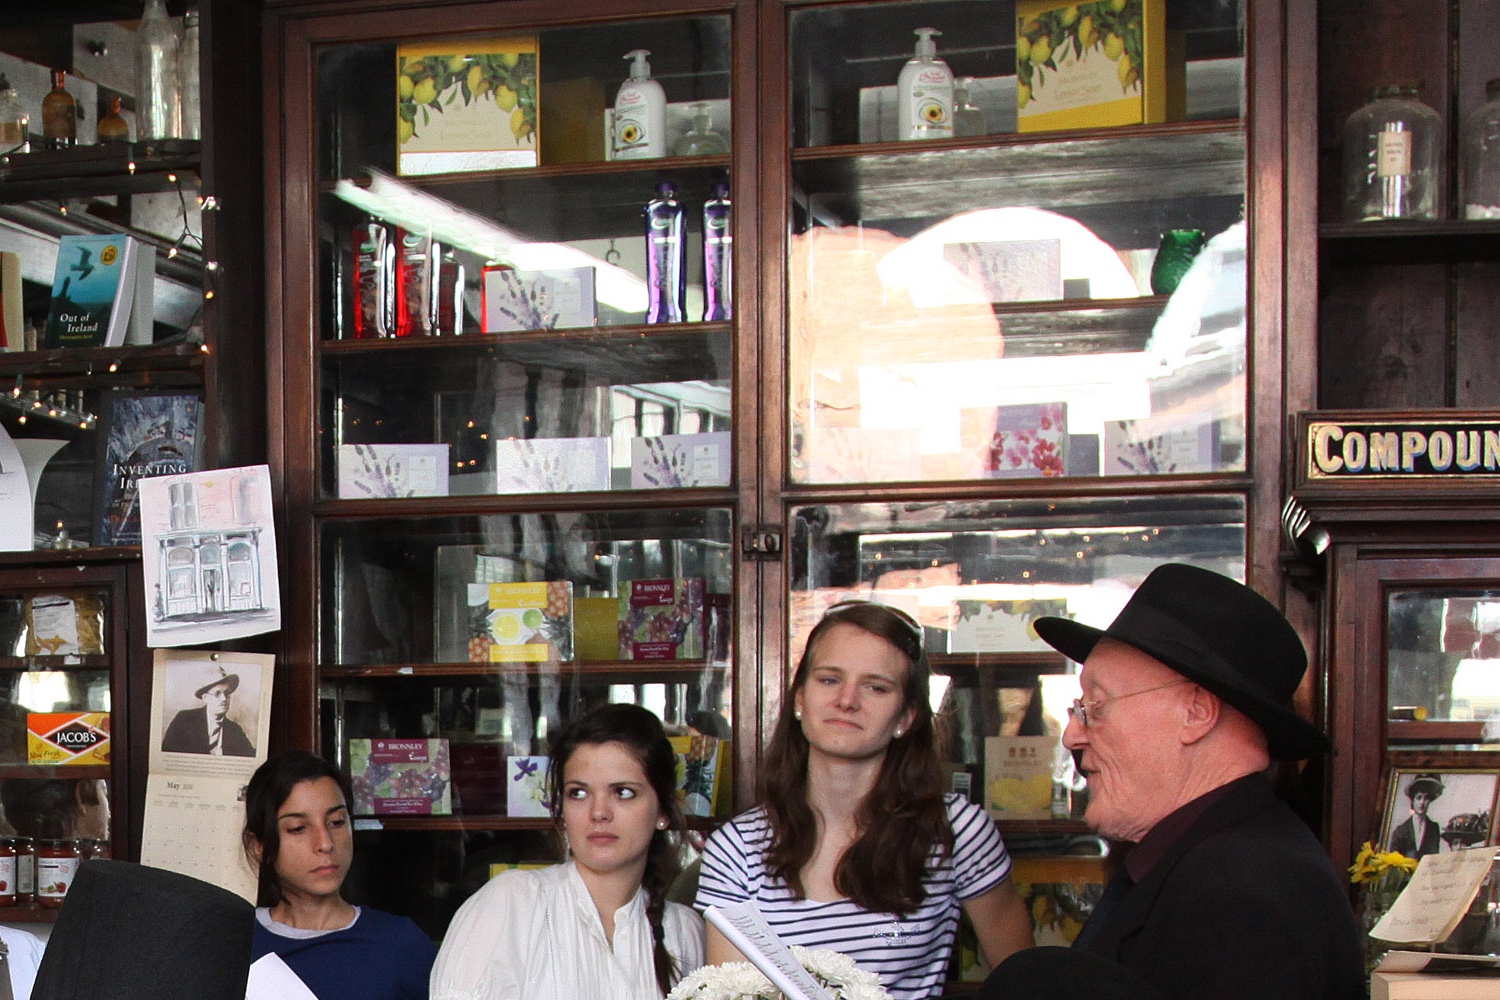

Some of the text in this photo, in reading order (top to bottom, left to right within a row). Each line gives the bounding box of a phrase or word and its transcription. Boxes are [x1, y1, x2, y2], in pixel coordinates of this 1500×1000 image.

[60, 311, 91, 322] Out of
[67, 322, 99, 332] Ireland
[113, 463, 187, 475] INVENTING
[56, 731, 97, 744] JACOB'S
[166, 781, 180, 790] May
